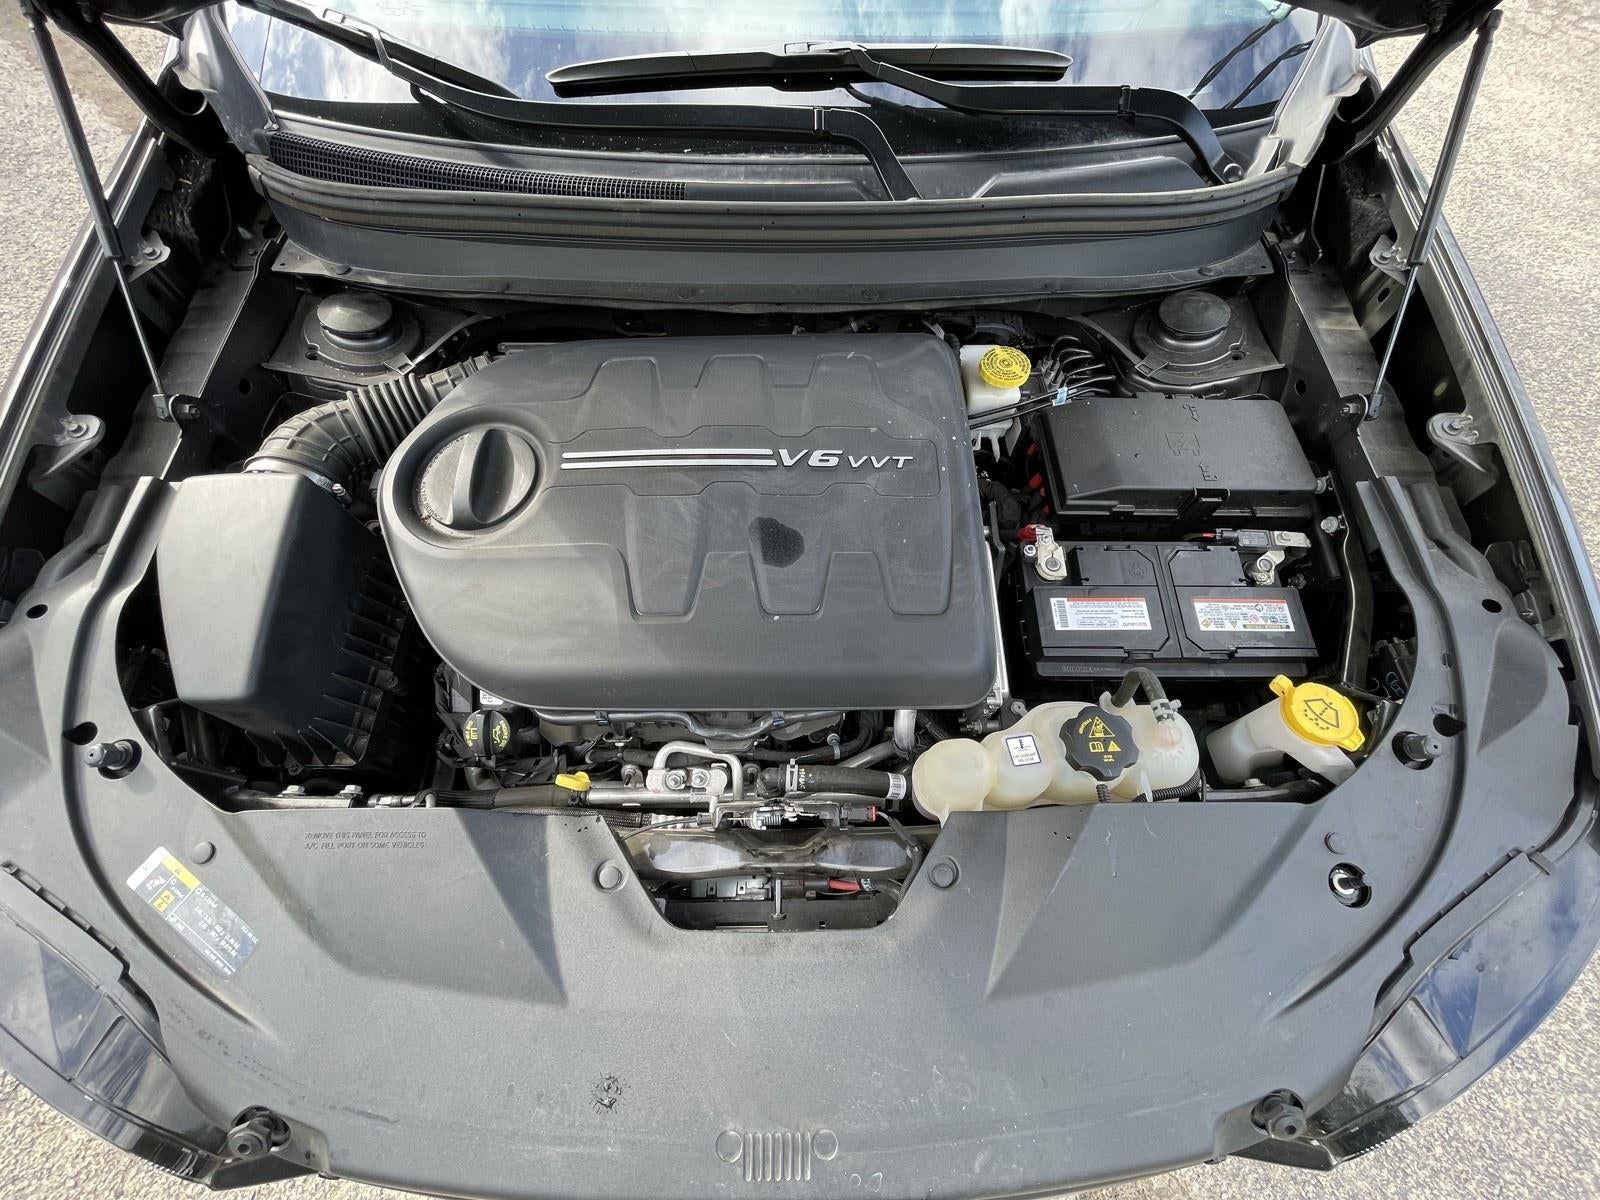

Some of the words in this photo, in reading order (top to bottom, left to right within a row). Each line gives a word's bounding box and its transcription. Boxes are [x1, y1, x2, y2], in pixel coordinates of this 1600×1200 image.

[778, 449, 843, 467] V6
[847, 455, 914, 469] VVT
[305, 831, 334, 839] REMOVE
[335, 831, 351, 839] THIS
[351, 831, 373, 839] PANEL
[374, 831, 389, 839] FOR
[389, 831, 416, 839] ACCESS
[417, 831, 427, 839] TO
[305, 841, 319, 850] A/C
[320, 841, 336, 849] FILL
[337, 841, 356, 849] PORT
[357, 841, 368, 849] ON
[370, 841, 390, 849] SOME
[391, 841, 425, 849] VEHICLES
